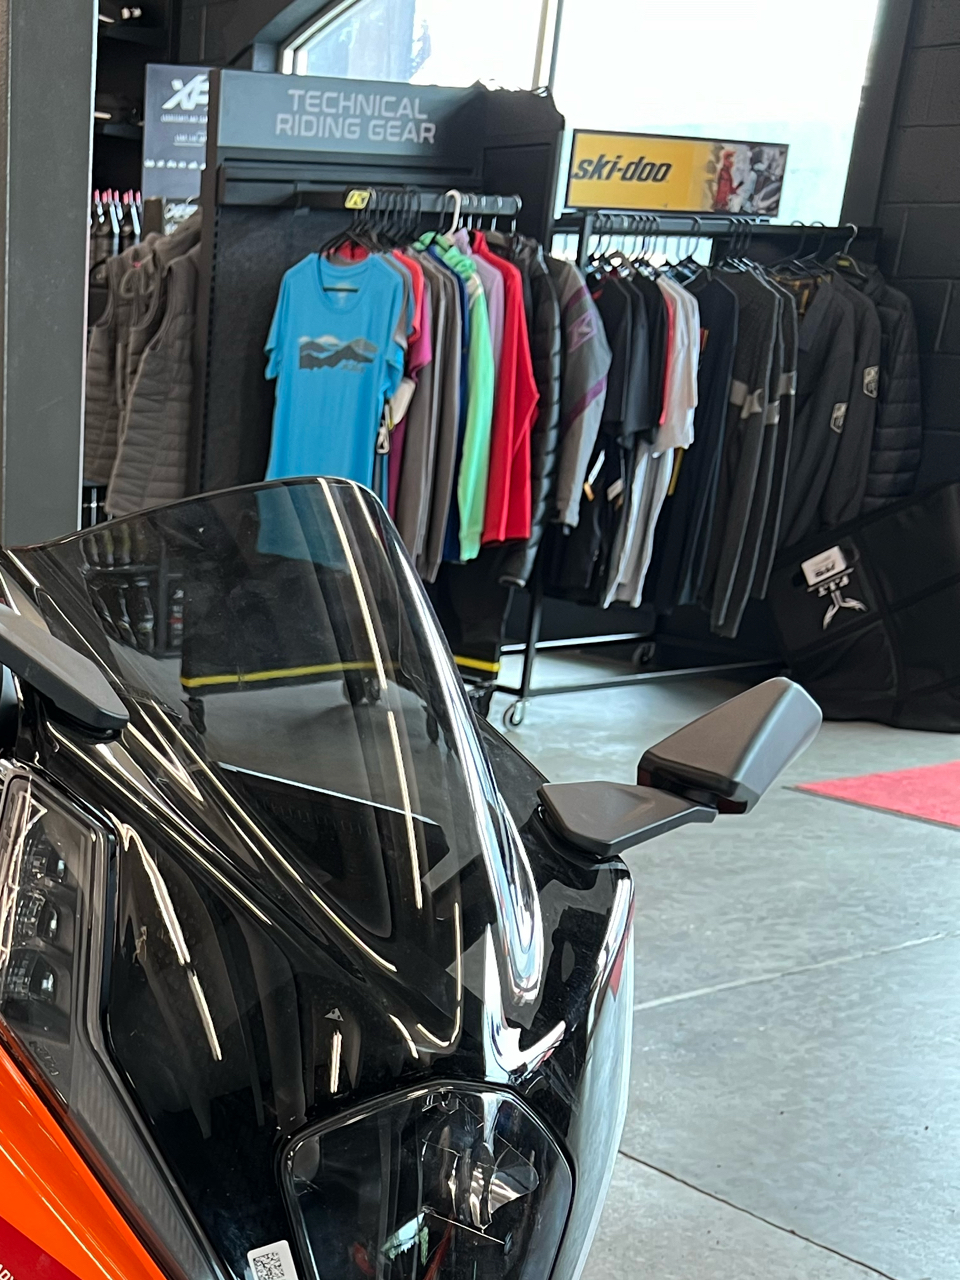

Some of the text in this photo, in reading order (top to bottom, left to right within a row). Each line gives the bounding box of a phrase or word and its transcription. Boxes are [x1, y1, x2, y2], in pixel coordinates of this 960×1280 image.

[287, 89, 429, 119] TECHNICAL
[275, 113, 437, 144] RIDING GEAR
[572, 153, 673, 183] ski-doo
